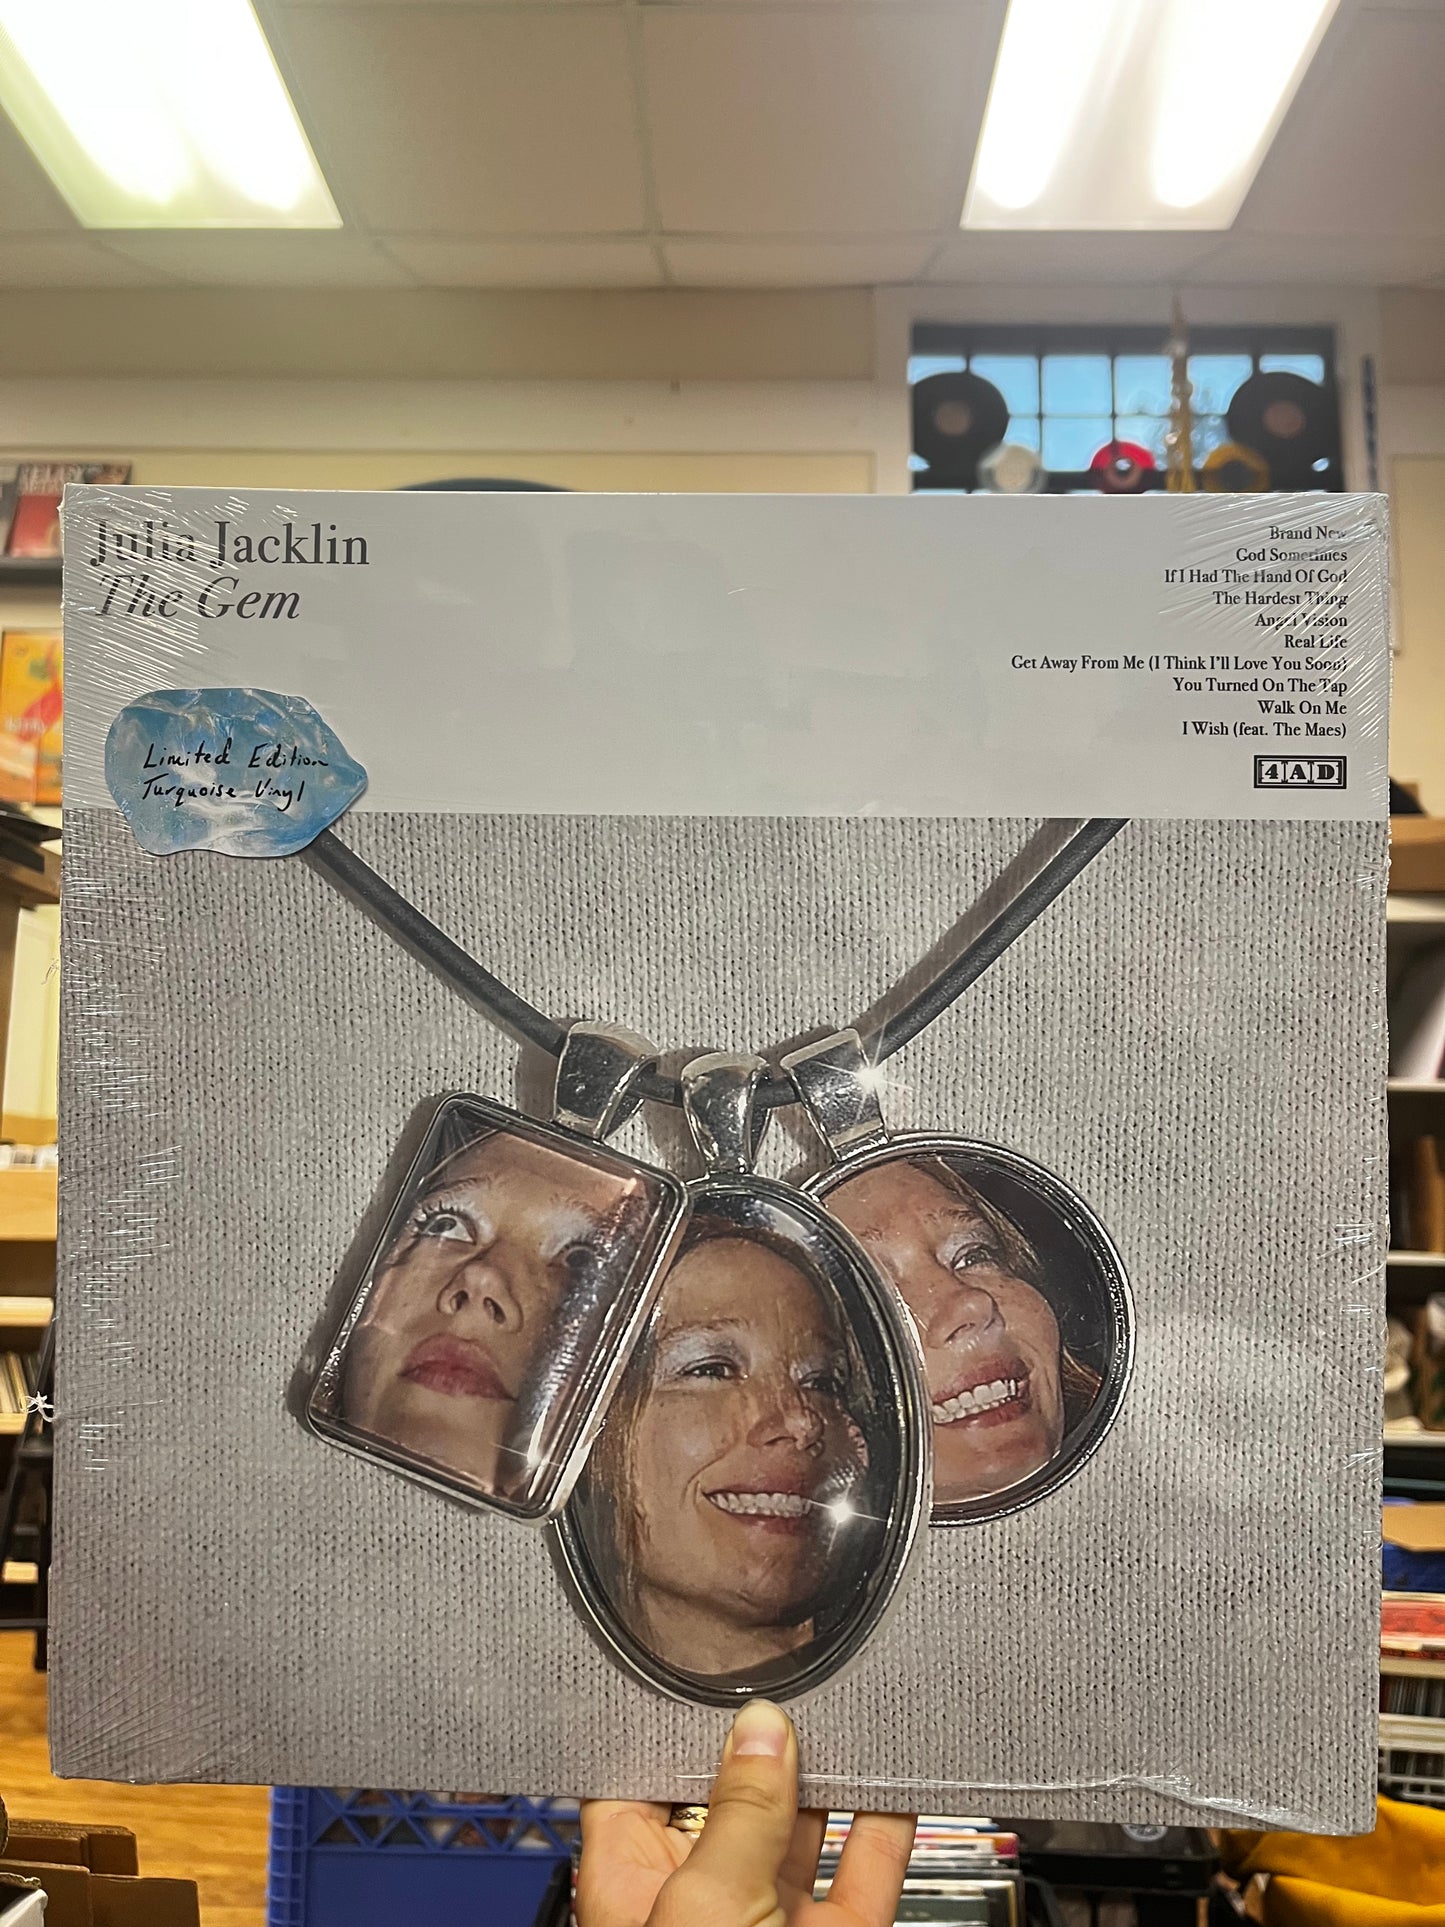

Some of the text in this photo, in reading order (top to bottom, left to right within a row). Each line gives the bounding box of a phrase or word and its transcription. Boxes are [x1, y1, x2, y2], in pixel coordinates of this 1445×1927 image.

[1269, 525, 1312, 540] Brand
[90, 519, 370, 568] Julia Jacklin
[1236, 547, 1348, 562] God Sometimes
[1164, 569, 1348, 583] If I Had The Hand Of God
[95, 574, 301, 620] The Gem
[1212, 591, 1349, 609] The Hardest Thing
[1254, 613, 1348, 631] Angel Vision
[1284, 634, 1348, 649] Real Life
[1011, 655, 1037, 669] Get
[1040, 655, 1078, 673] Away
[1081, 655, 1119, 669] From
[1123, 655, 1145, 669] Me
[1148, 655, 1160, 671] (I
[1164, 655, 1206, 670] Think
[1233, 656, 1268, 670] Love
[1271, 656, 1301, 670] You
[1304, 656, 1348, 672] Soon)
[1173, 677, 1348, 697] You Turned On The Tap
[1257, 700, 1348, 715] Walk On Me
[1182, 721, 1347, 738] I Wish (feat. The Maes)
[143, 737, 329, 768] Limited Edition
[1261, 761, 1339, 782] 4AD
[142, 773, 305, 812] Turquoise Vinyl
